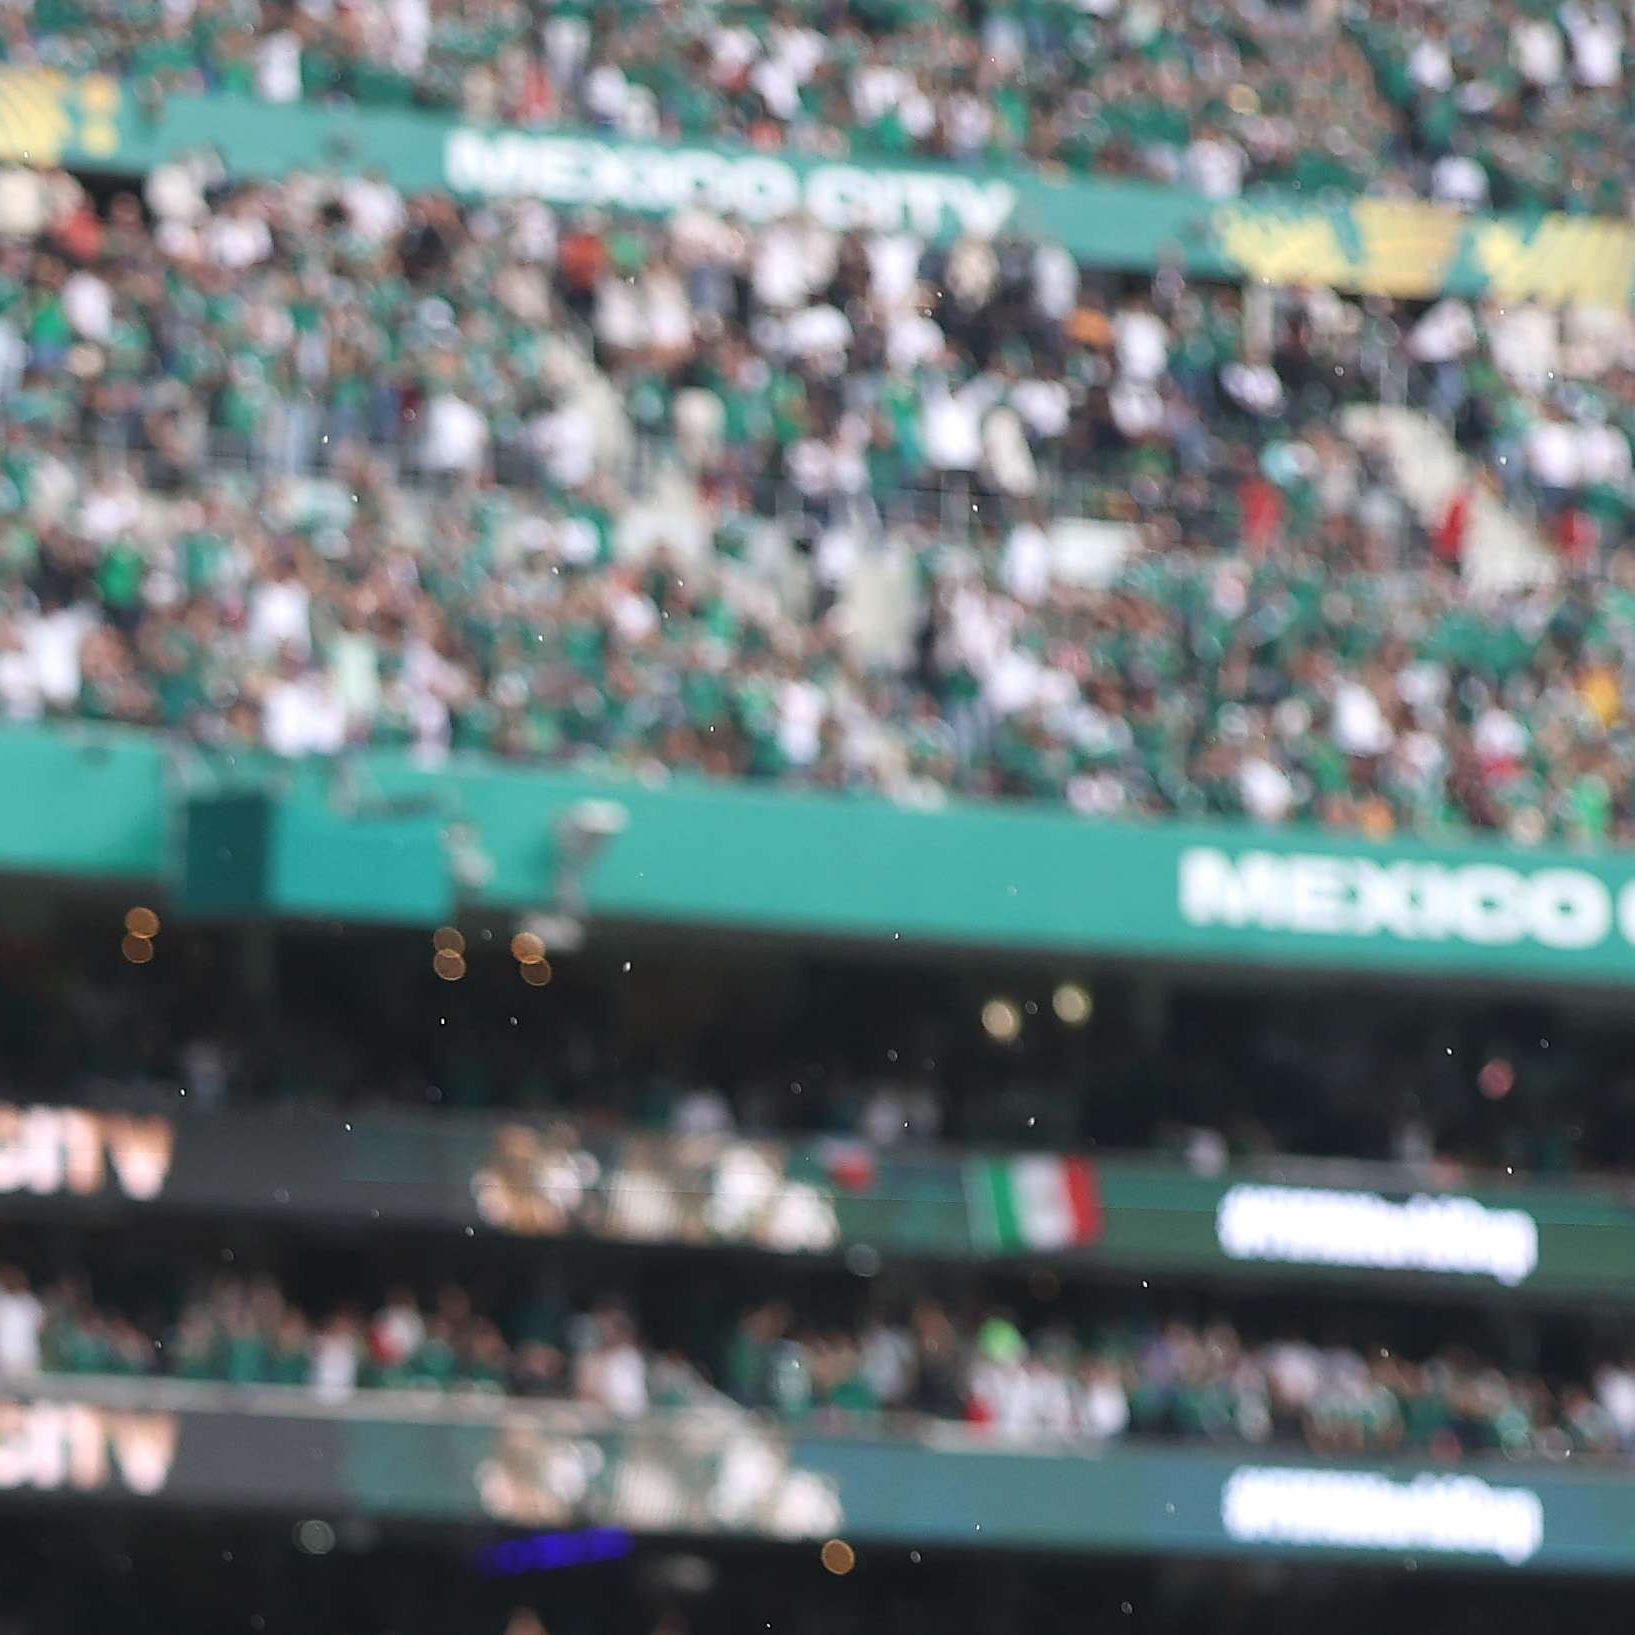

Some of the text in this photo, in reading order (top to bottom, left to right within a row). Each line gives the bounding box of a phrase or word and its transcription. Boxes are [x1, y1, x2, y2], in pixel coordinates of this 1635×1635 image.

[445, 130, 1015, 240] MEXICO CITY
[1179, 847, 1611, 948] MEXICO
